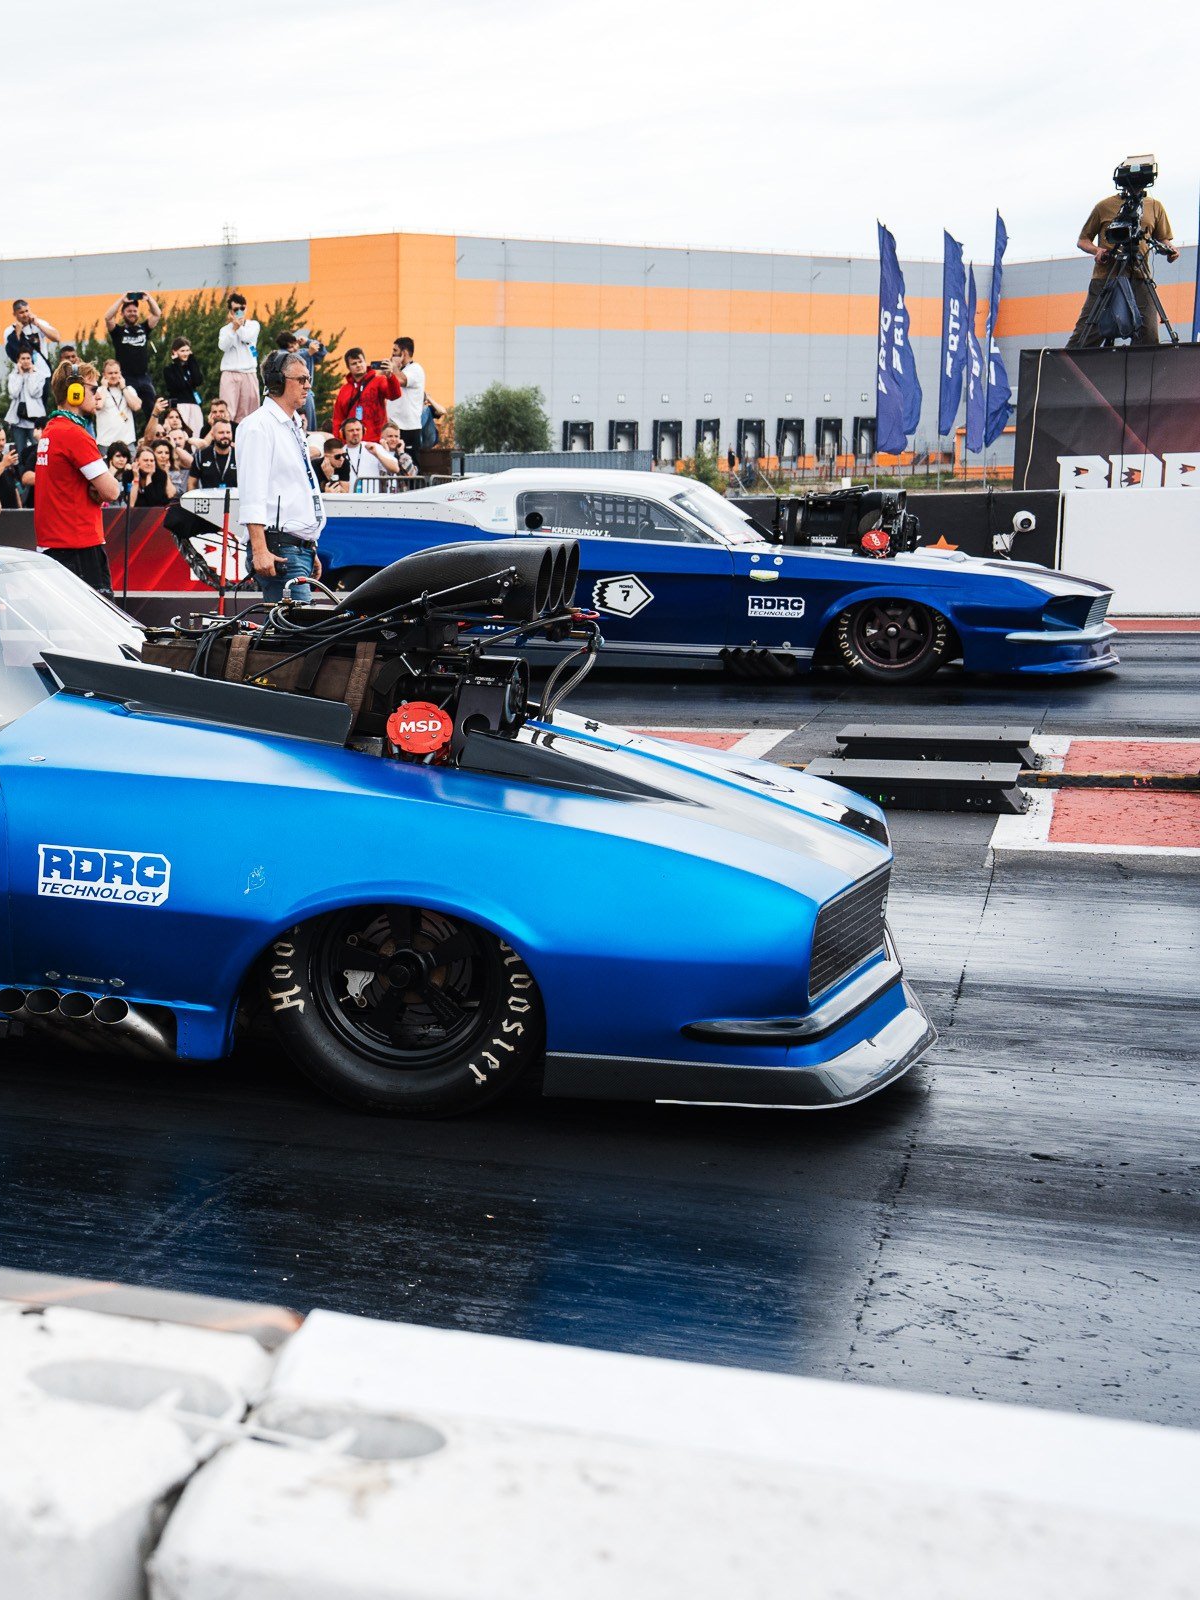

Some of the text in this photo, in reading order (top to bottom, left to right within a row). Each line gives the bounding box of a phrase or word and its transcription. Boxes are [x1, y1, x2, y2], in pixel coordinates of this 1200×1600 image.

[551, 526, 603, 537] KRIKSUNOV
[621, 589, 630, 602] 7
[750, 597, 803, 611] RDRC
[399, 720, 442, 734] MSD
[42, 847, 167, 888] RDRC
[40, 881, 163, 903] TECHNOLOGY
